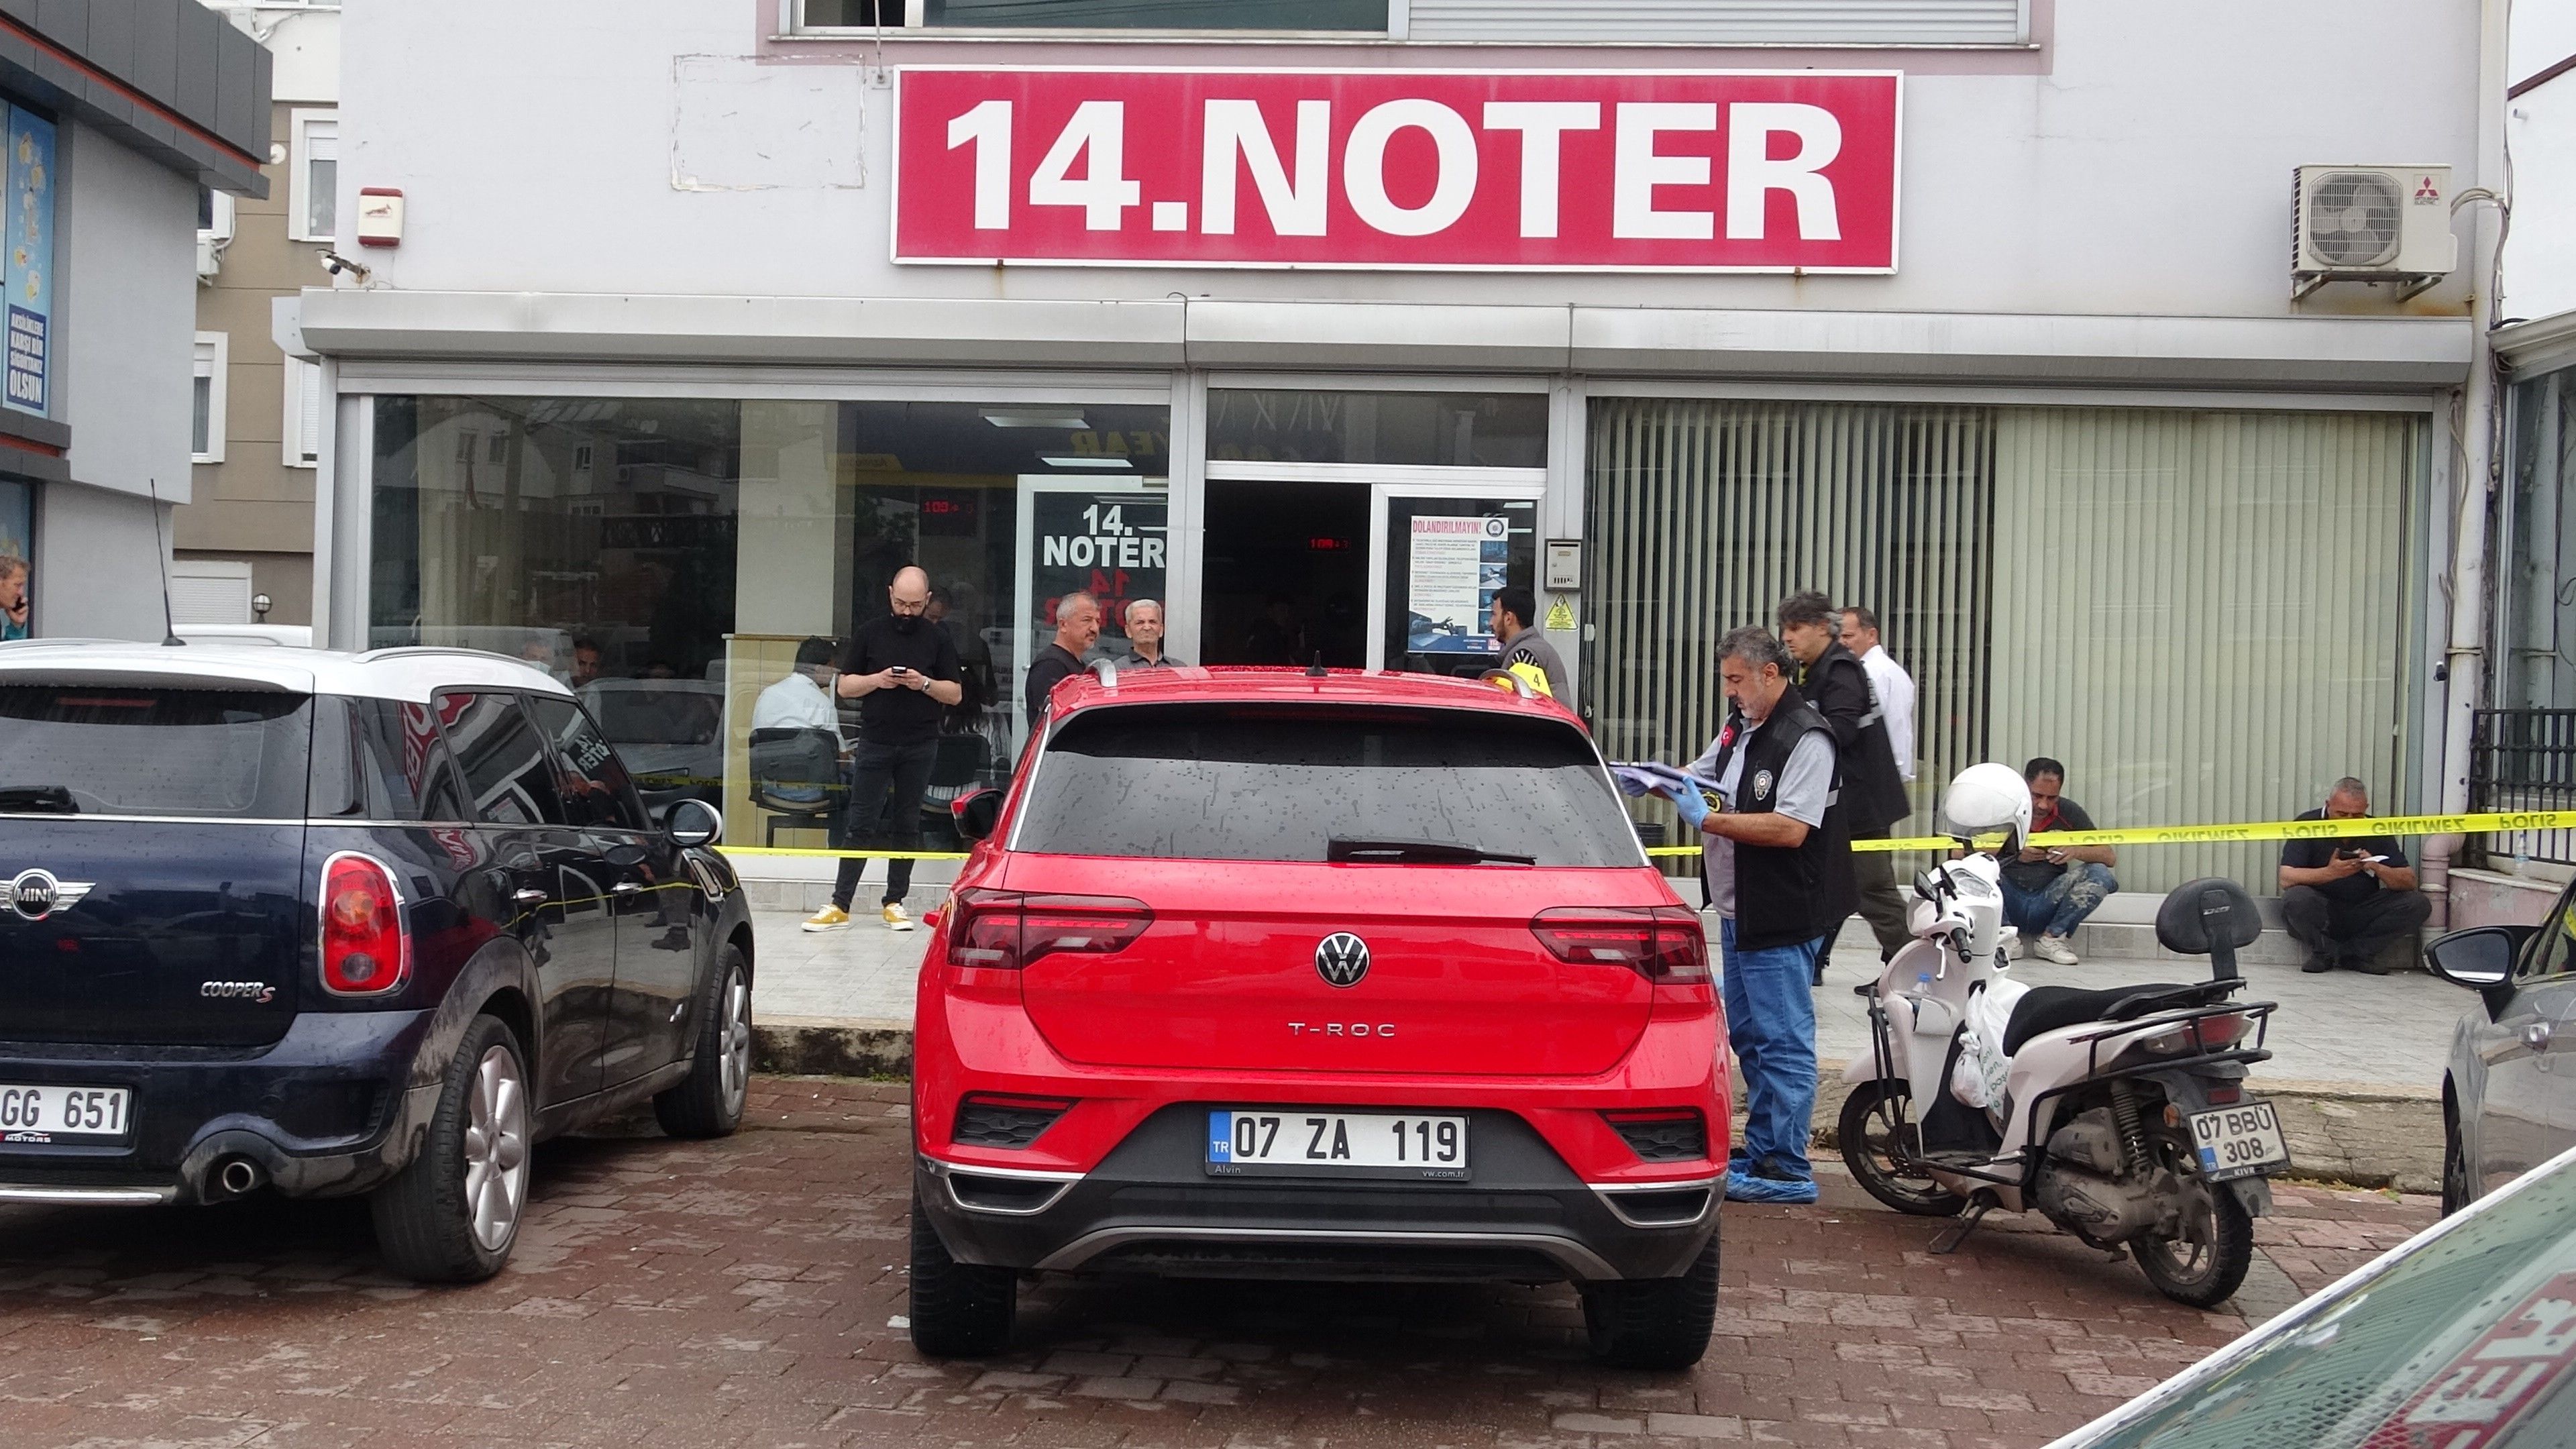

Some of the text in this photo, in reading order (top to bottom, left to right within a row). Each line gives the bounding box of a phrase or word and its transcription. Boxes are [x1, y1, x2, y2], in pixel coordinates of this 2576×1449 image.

[9, 369, 43, 403] OLSUN
[1082, 504, 1133, 535] 14.
[1413, 520, 1481, 534] DOLANDIRILMAYIN!
[1044, 536, 1165, 568] NOTER
[1534, 674, 1541, 687] 4
[16, 888, 52, 902] MINI
[201, 981, 264, 998] COOPER
[1287, 1022, 1395, 1037] T-ROC
[1, 1089, 121, 1130] GG 651
[2196, 1114, 2221, 1140] 07
[1213, 1141, 1229, 1153] TR
[1235, 1117, 1458, 1162] 07 ZA 119
[2223, 1137, 2264, 1163] 308
[1214, 1165, 1241, 1174] Alvin
[1422, 1169, 1464, 1179] vw.com.tr
